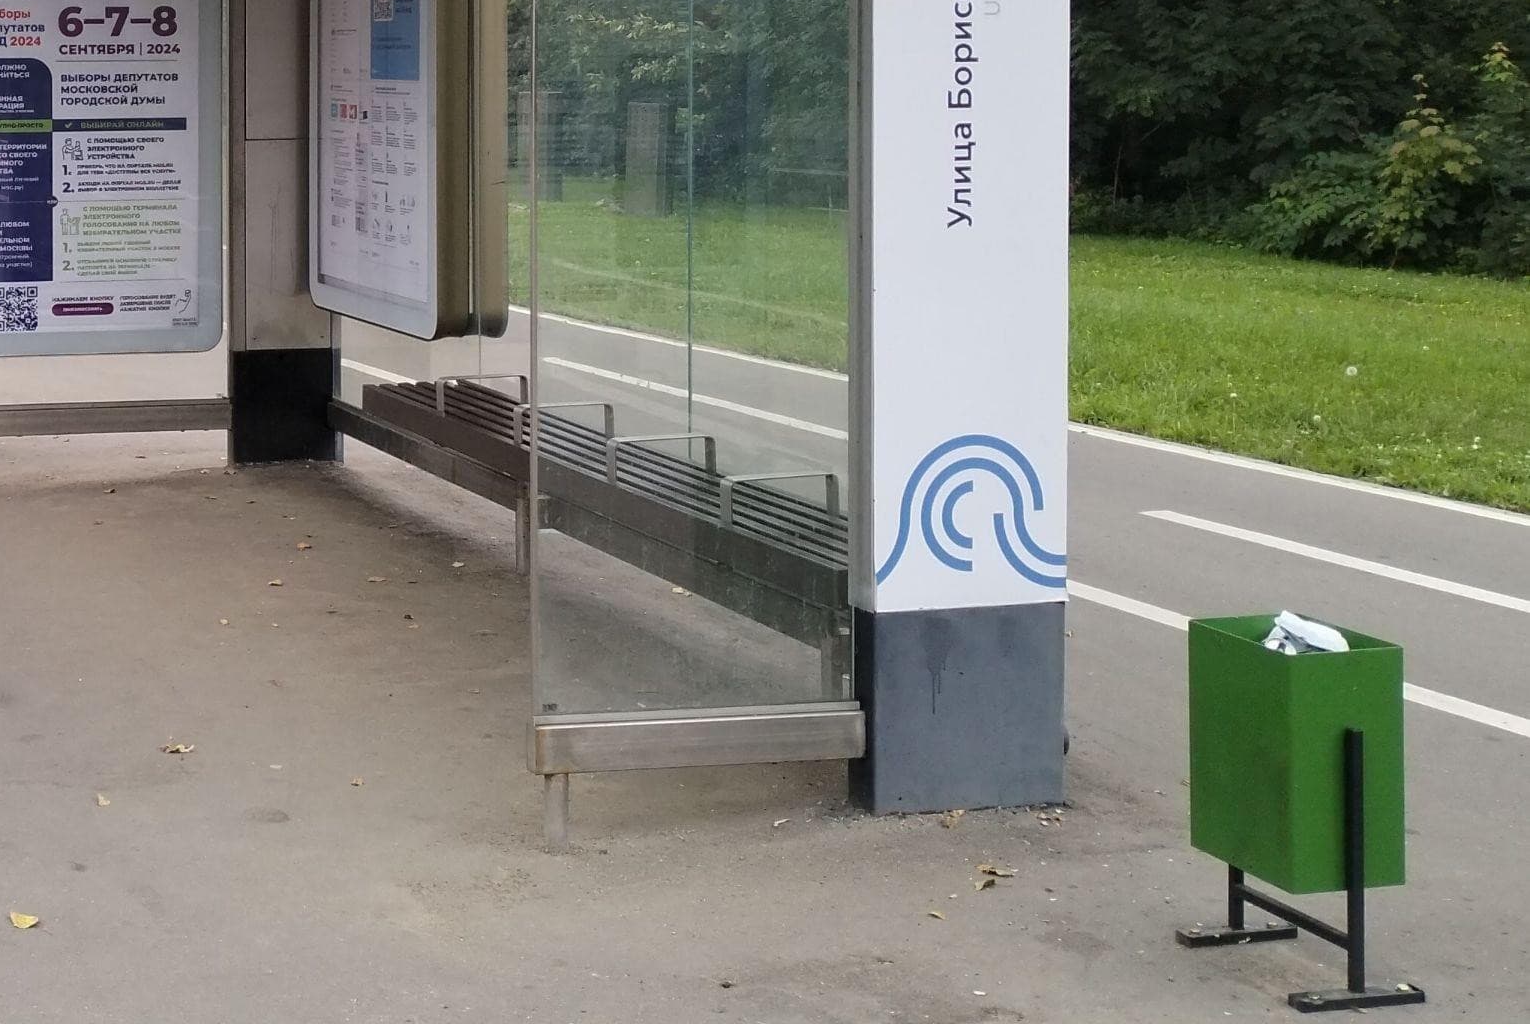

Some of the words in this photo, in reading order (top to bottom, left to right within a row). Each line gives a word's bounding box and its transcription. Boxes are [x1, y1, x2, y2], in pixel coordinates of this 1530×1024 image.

[10, 36, 41, 47] 2024
[59, 44, 135, 56] СЕНТЯБРЯ
[146, 43, 181, 55] 2024
[60, 73, 110, 83] ВЫБОРЫ
[113, 73, 179, 83] ДЕПУТАТОВ
[60, 83, 138, 94] МОСКОВСКОЙ
[60, 94, 128, 106] ГОРОДСКОЙ
[130, 96, 166, 106] ДУМЫ
[80, 121, 126, 129] ВЫБИРАЙ
[127, 120, 164, 128] ОНЛАЙН
[947, 123, 976, 228] Улица
